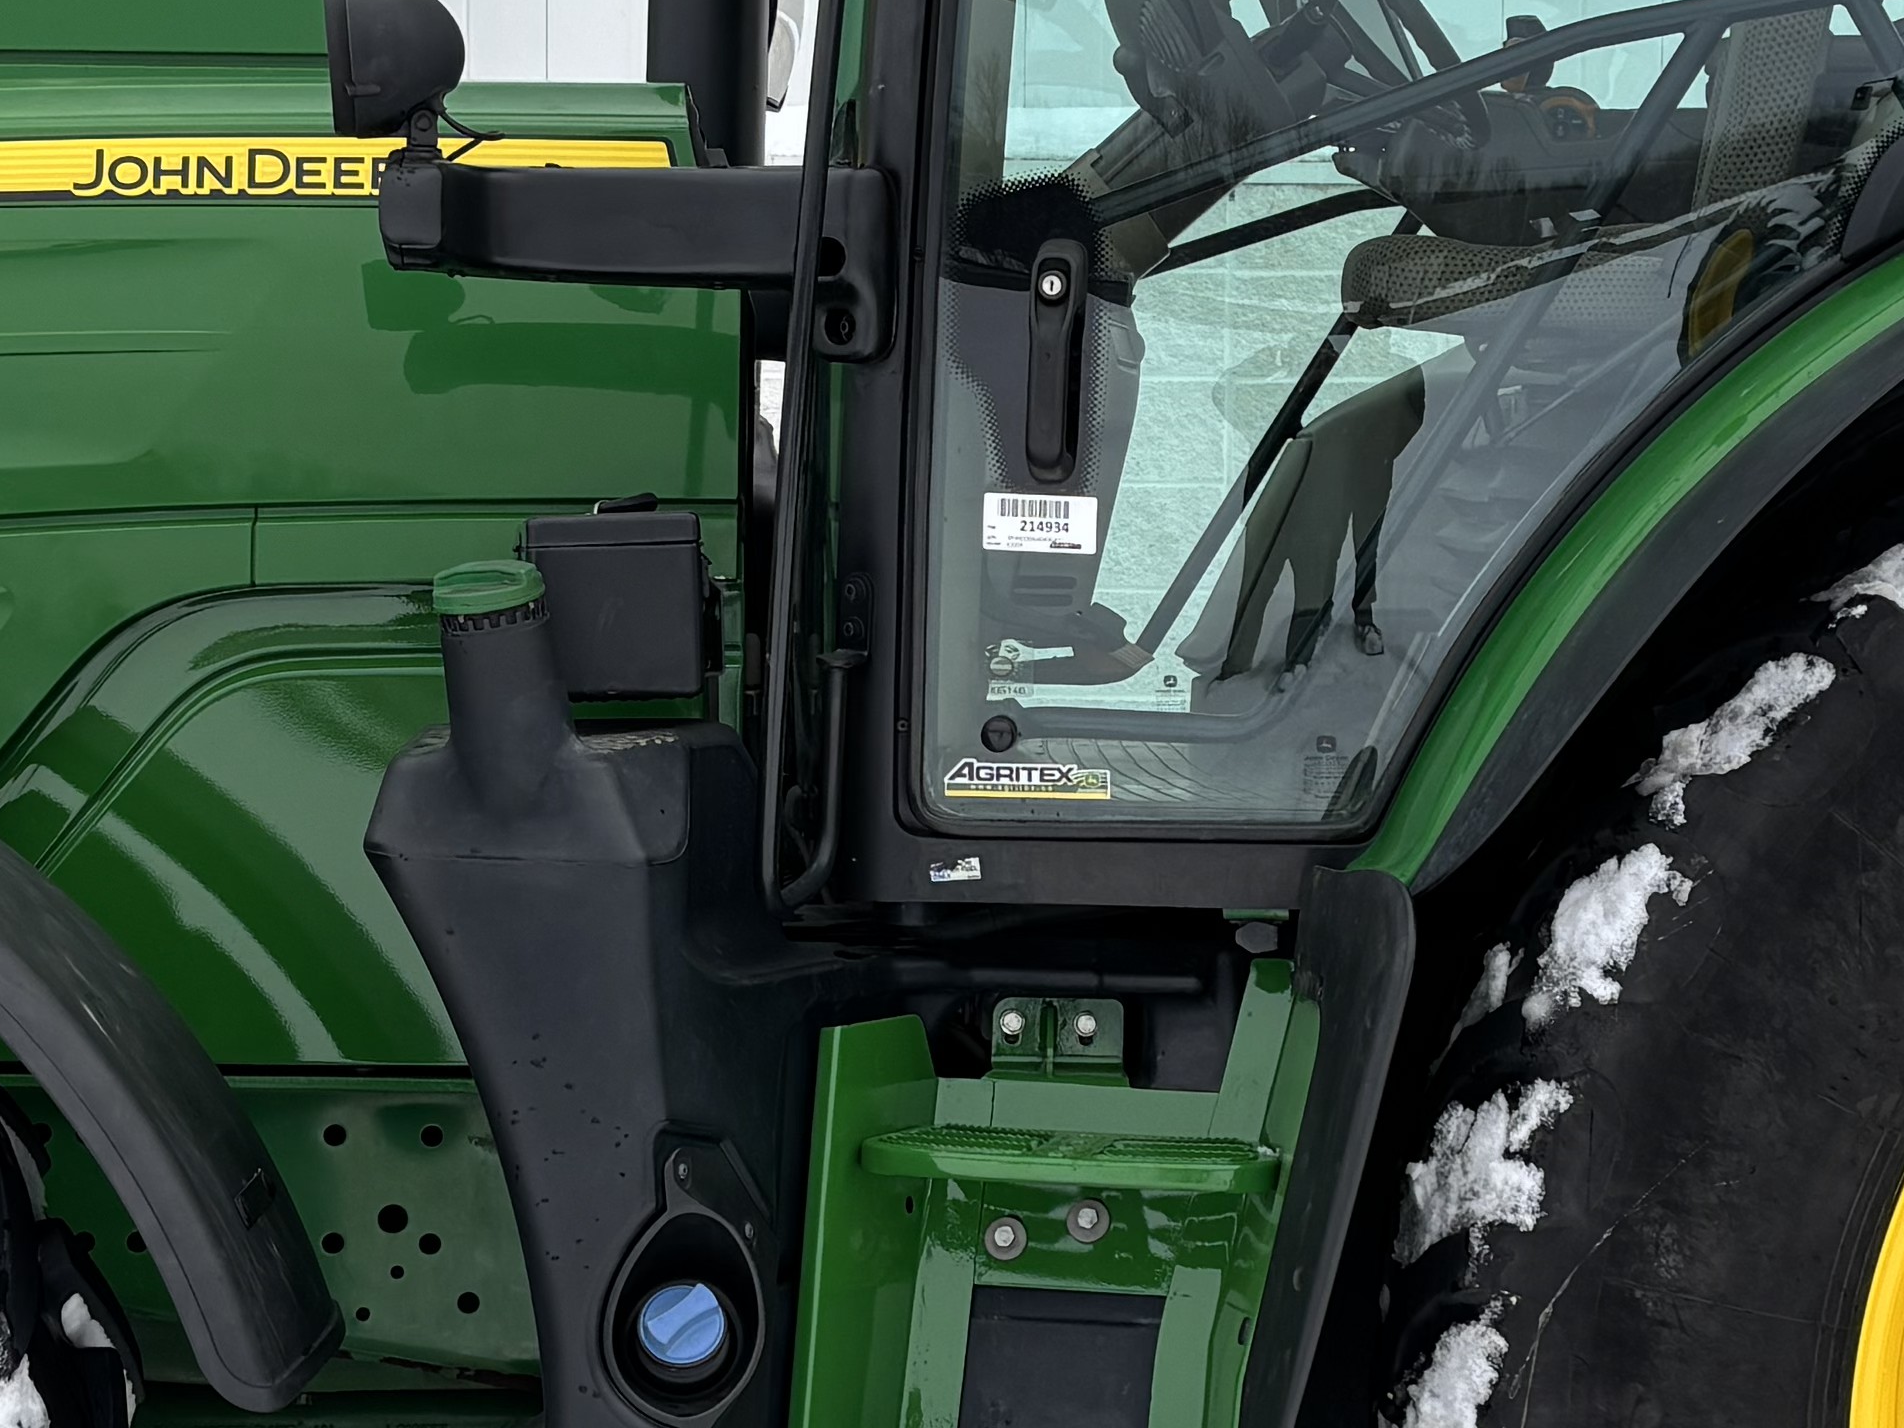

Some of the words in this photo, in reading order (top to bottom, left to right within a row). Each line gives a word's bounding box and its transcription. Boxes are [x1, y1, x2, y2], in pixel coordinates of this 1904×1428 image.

[72, 148, 234, 191] JOHN
[1020, 520, 1070, 533] 214934
[947, 761, 1075, 784] AGRITEX
